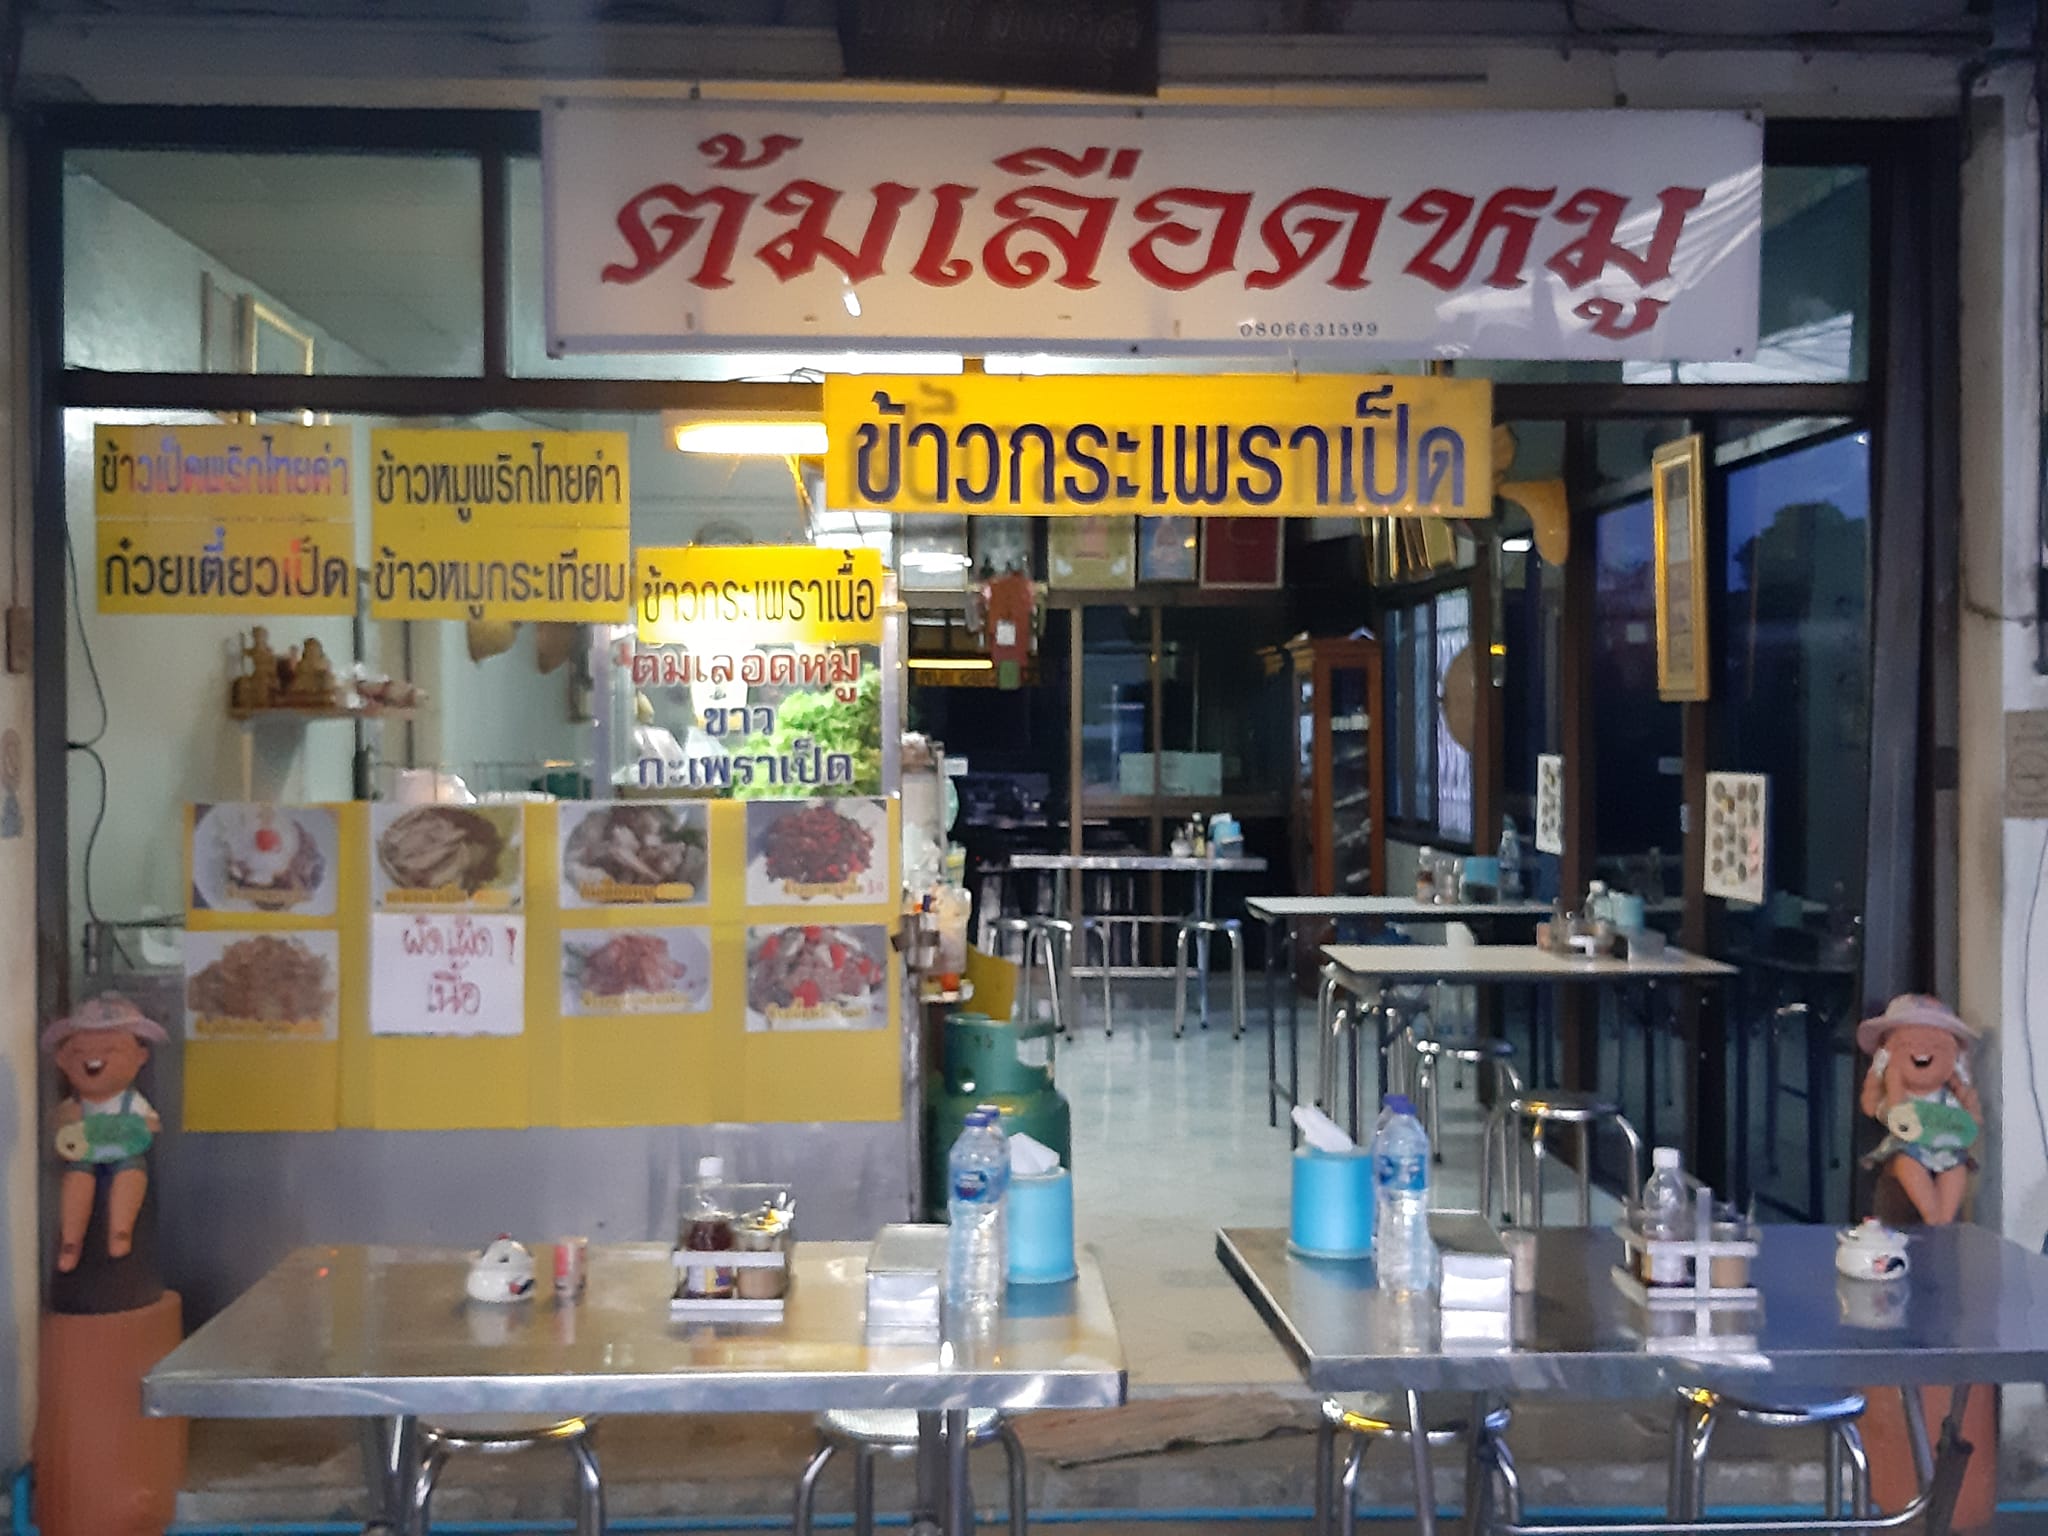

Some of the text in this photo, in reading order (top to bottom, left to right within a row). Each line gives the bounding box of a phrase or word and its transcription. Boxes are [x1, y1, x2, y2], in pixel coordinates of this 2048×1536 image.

[601, 132, 1706, 338] ต้มเลือดหมู
[1239, 322, 1378, 337] 0806631599
[101, 436, 349, 496] ข้าวเป็ดพริกไทยดำ
[856, 384, 1465, 506] ข้าวกระเพราเป็ด
[376, 442, 622, 522] ข้าวหมูพริกไทยดำ
[105, 526, 349, 598] ก๋วยเตี๋ยวเป็ด
[374, 546, 625, 619] ข้าวหมูกระเทียม
[643, 549, 875, 623] ข้าวกระเพราเนื้อ
[638, 737, 853, 788] กะเพราเป็ด
